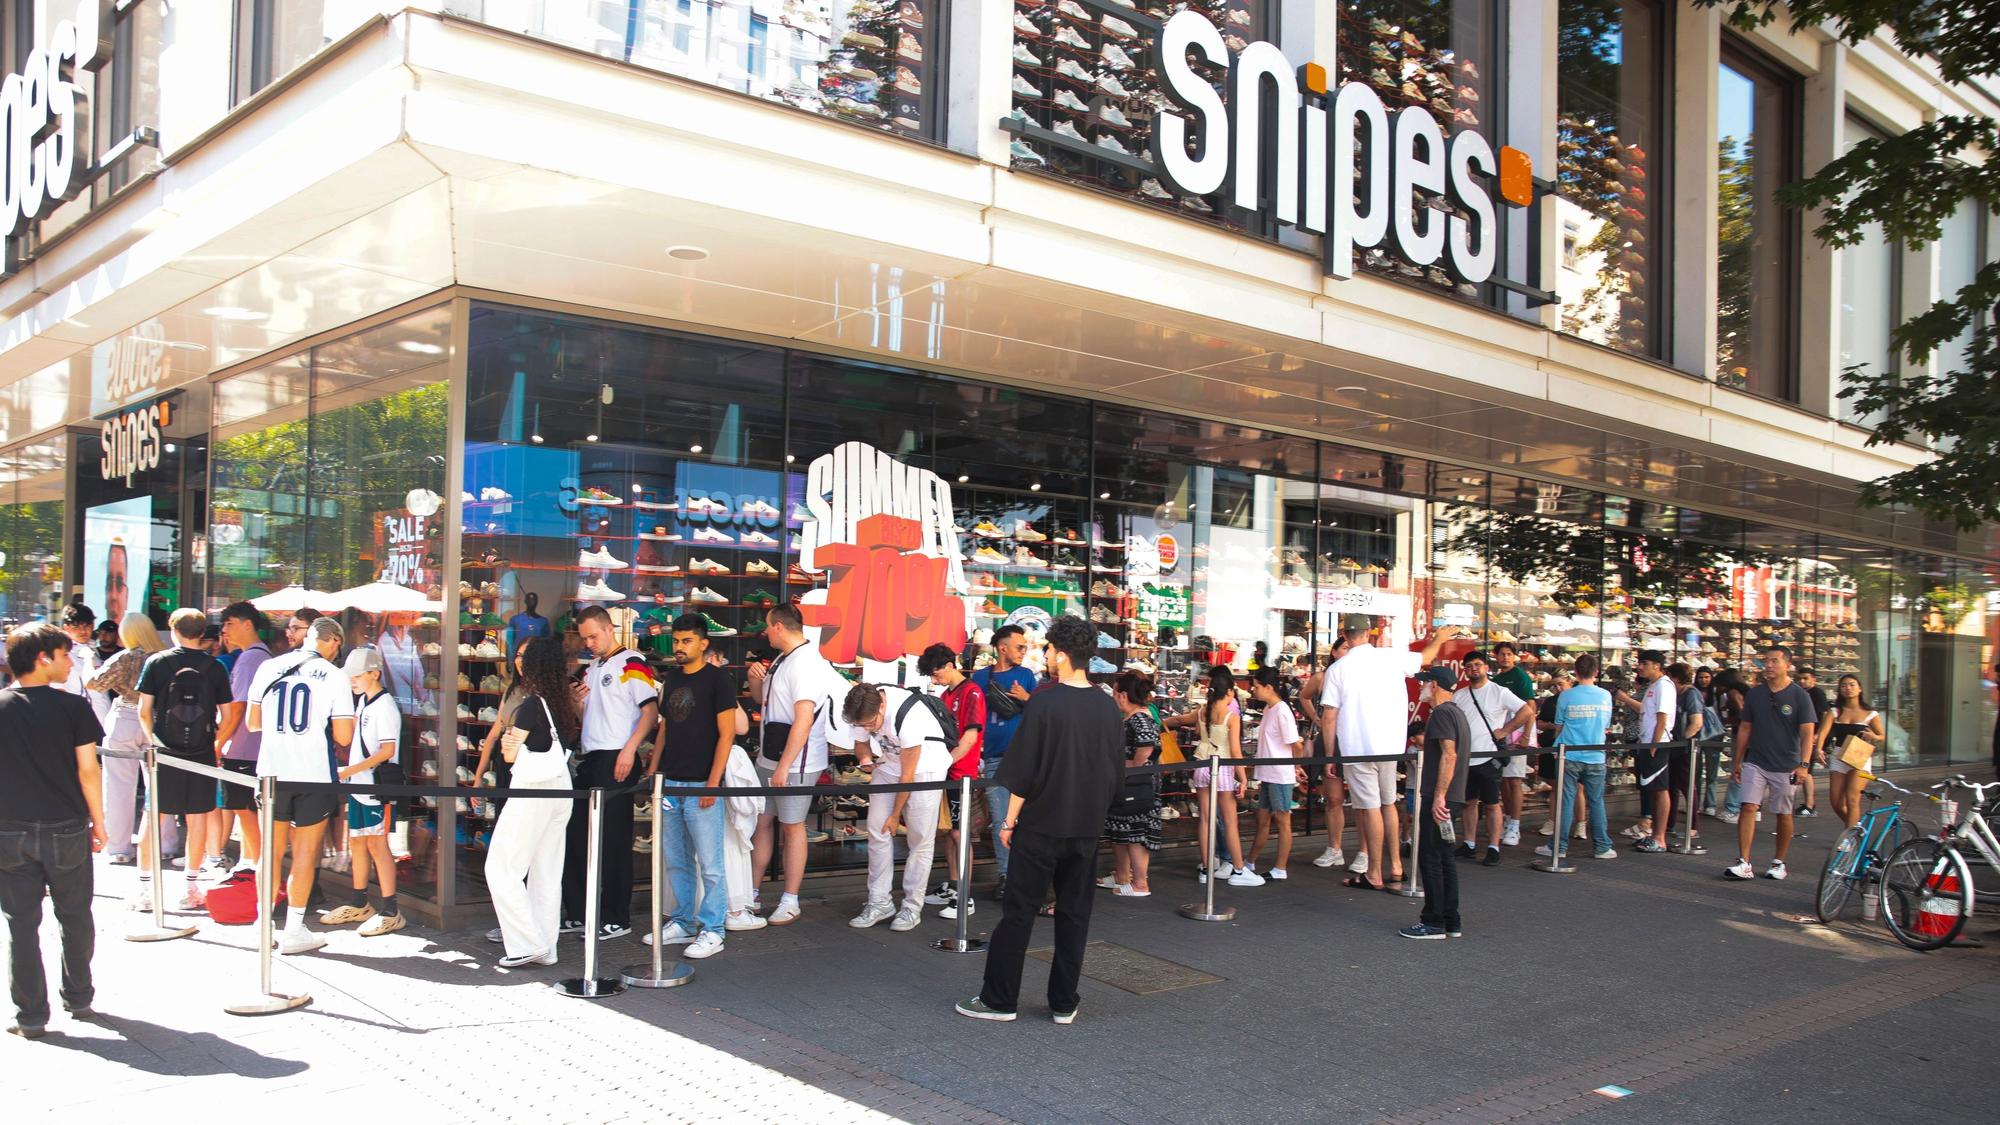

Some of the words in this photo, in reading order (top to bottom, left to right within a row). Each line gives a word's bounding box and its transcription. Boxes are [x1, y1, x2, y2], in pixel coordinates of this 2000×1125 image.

[1159, 10, 1497, 284] snipes
[101, 405, 160, 488] snipes
[388, 516, 425, 543] SALE
[799, 441, 970, 597] SUMMER
[271, 681, 312, 735] 10
